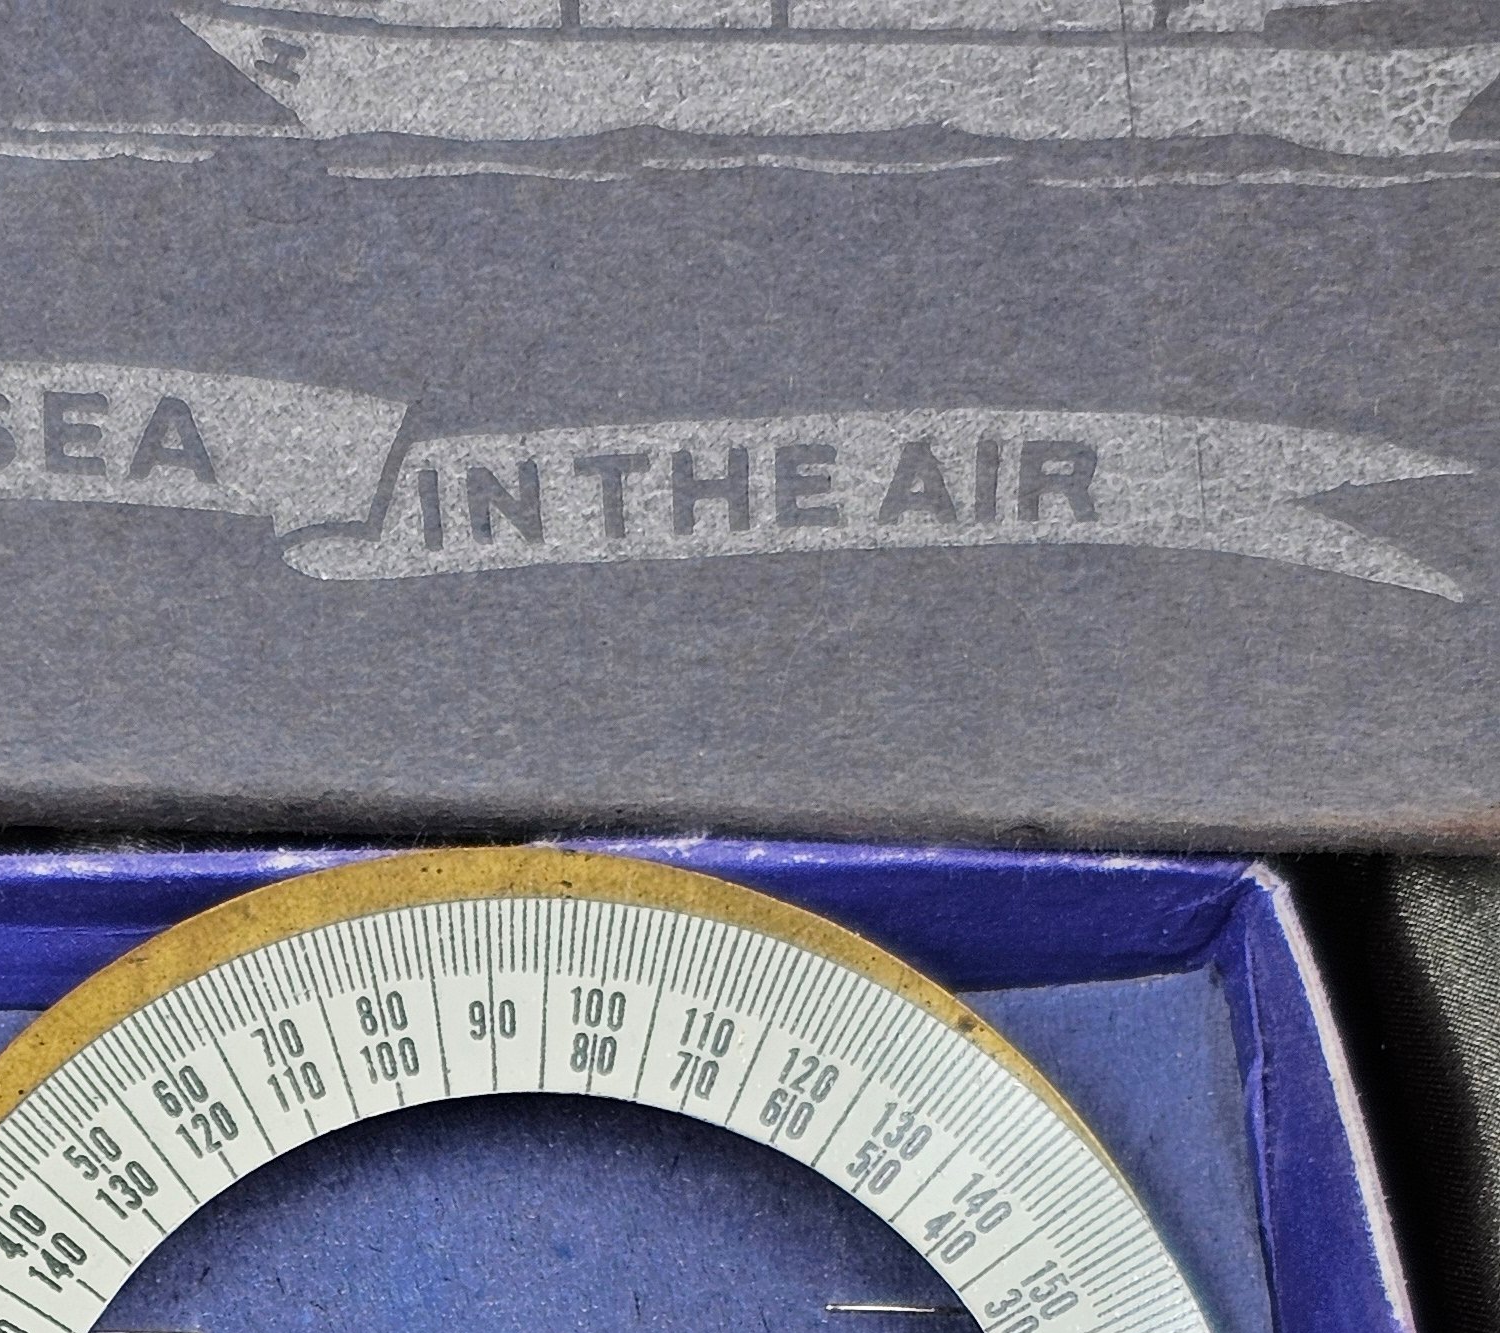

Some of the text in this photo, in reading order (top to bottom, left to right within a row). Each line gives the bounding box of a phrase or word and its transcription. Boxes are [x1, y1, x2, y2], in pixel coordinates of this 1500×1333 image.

[417, 439, 1098, 551] IN THE AIR
[356, 990, 408, 1036] 80
[469, 999, 516, 1040] 90
[571, 986, 626, 1032] 100
[680, 1008, 735, 1058] 110
[250, 1019, 304, 1067] 70
[360, 1037, 419, 1084] 100
[570, 1032, 617, 1076] 80
[152, 1065, 208, 1118] 60
[267, 1061, 326, 1112] 110
[670, 1051, 720, 1100] 70
[778, 1047, 839, 1103] 120
[175, 1101, 238, 1158] 120
[759, 1088, 815, 1139] 60
[872, 1102, 933, 1161] 130
[63, 1126, 122, 1180] 50
[846, 1140, 902, 1195] 50
[96, 1161, 158, 1220] 130
[952, 1172, 1012, 1234] 140
[28, 1233, 87, 1293] 140
[924, 1211, 976, 1264] 40
[1020, 1259, 1079, 1321] 150
